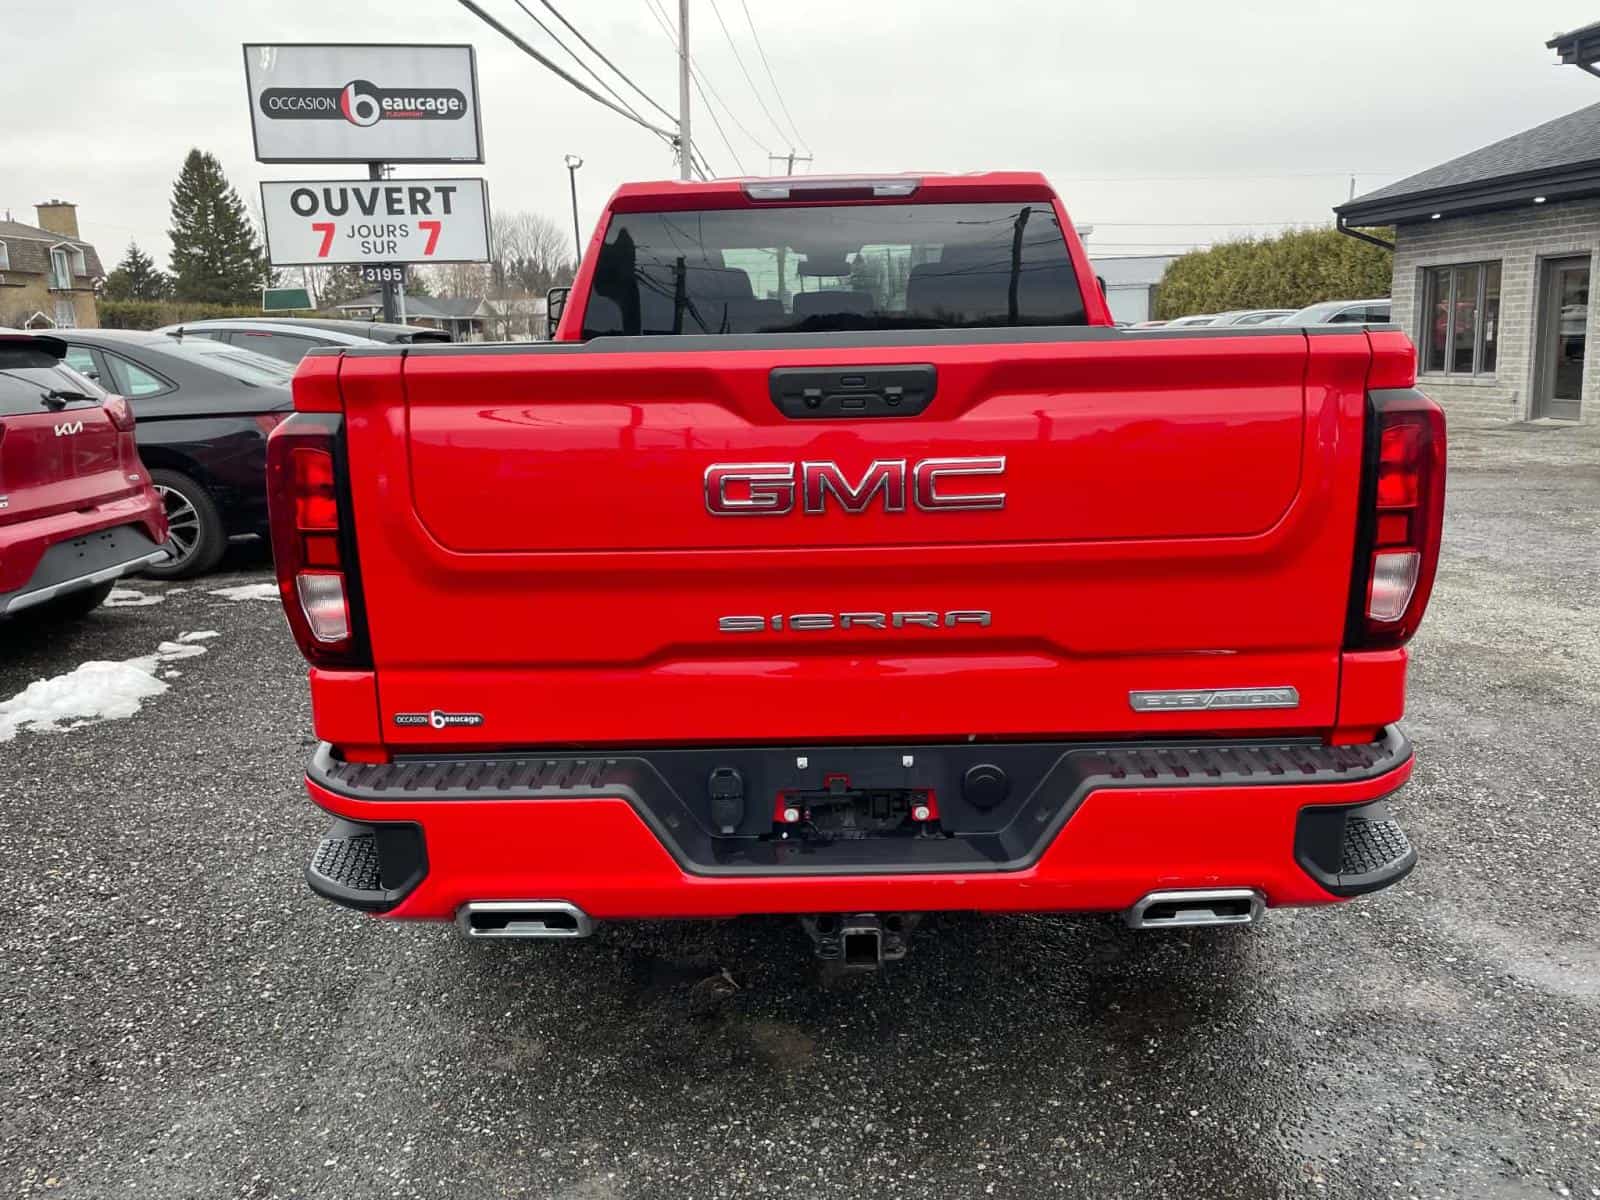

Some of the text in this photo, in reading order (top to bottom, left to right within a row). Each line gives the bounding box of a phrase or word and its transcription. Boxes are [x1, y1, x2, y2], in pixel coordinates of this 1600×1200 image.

[269, 96, 337, 110] OCCASION
[290, 186, 457, 217] OUVERT
[311, 221, 442, 257] 7 JOURS 7
[361, 240, 398, 254] SUR
[366, 268, 402, 281] 3195
[704, 455, 1006, 516] GMC
[718, 610, 992, 632] SIERRA
[1139, 689, 1294, 707] ELEVATION
[396, 715, 428, 723] OCCASION
